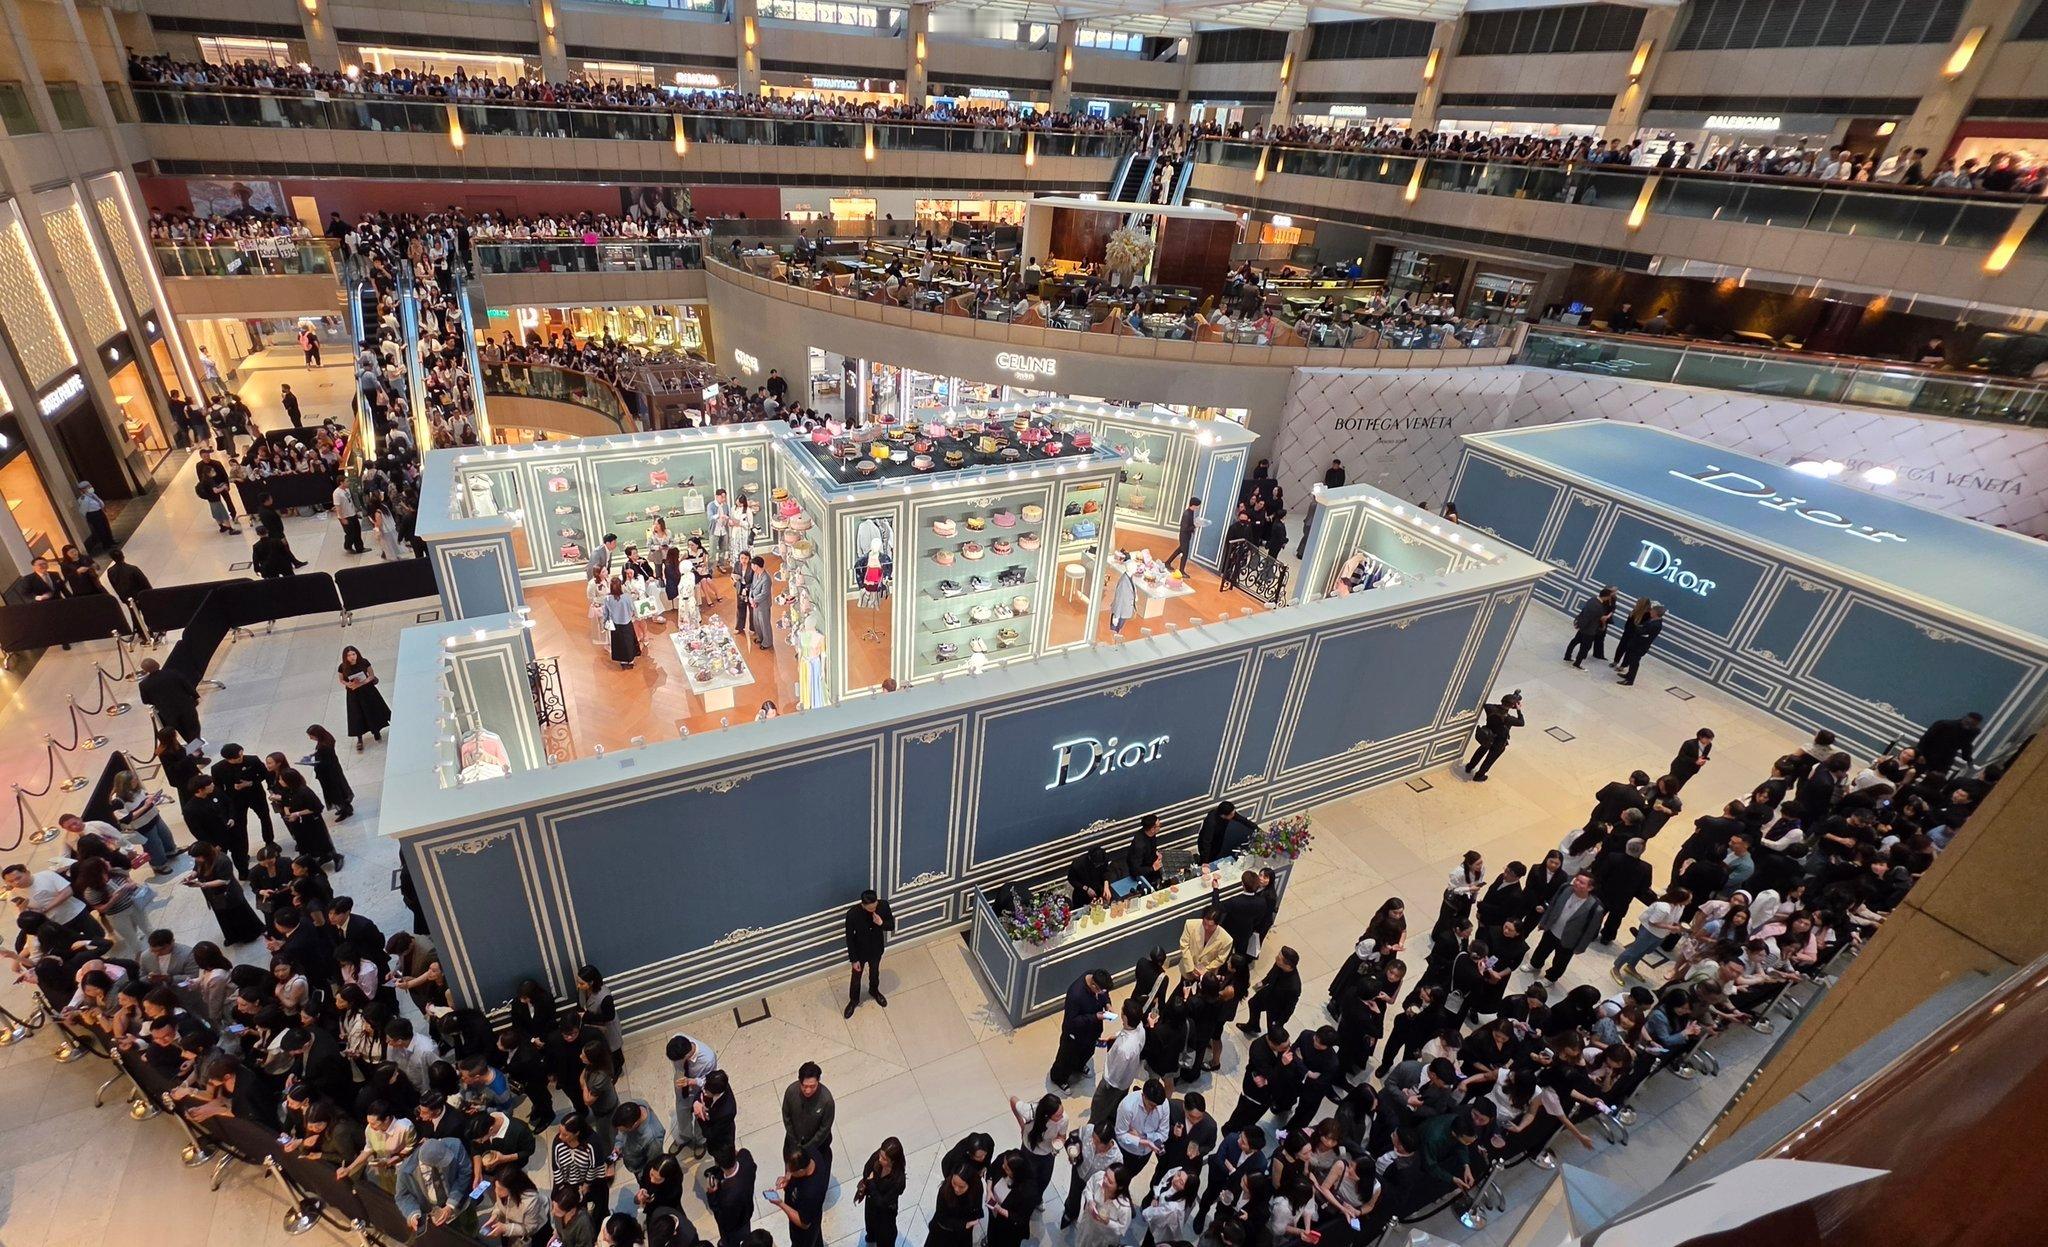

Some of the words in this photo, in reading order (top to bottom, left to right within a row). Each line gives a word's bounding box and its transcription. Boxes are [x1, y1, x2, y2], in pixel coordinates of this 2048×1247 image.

[1702, 115, 1781, 131] BALENCIAGA
[996, 352, 1057, 376] CELINE
[1334, 418, 1399, 431] BOTTEGA
[1405, 416, 1452, 429] VENETA
[1946, 472, 2022, 496] VENETA
[1667, 464, 1907, 543] Dior
[1628, 539, 1716, 597] Dior
[1045, 735, 1170, 791] Dior
